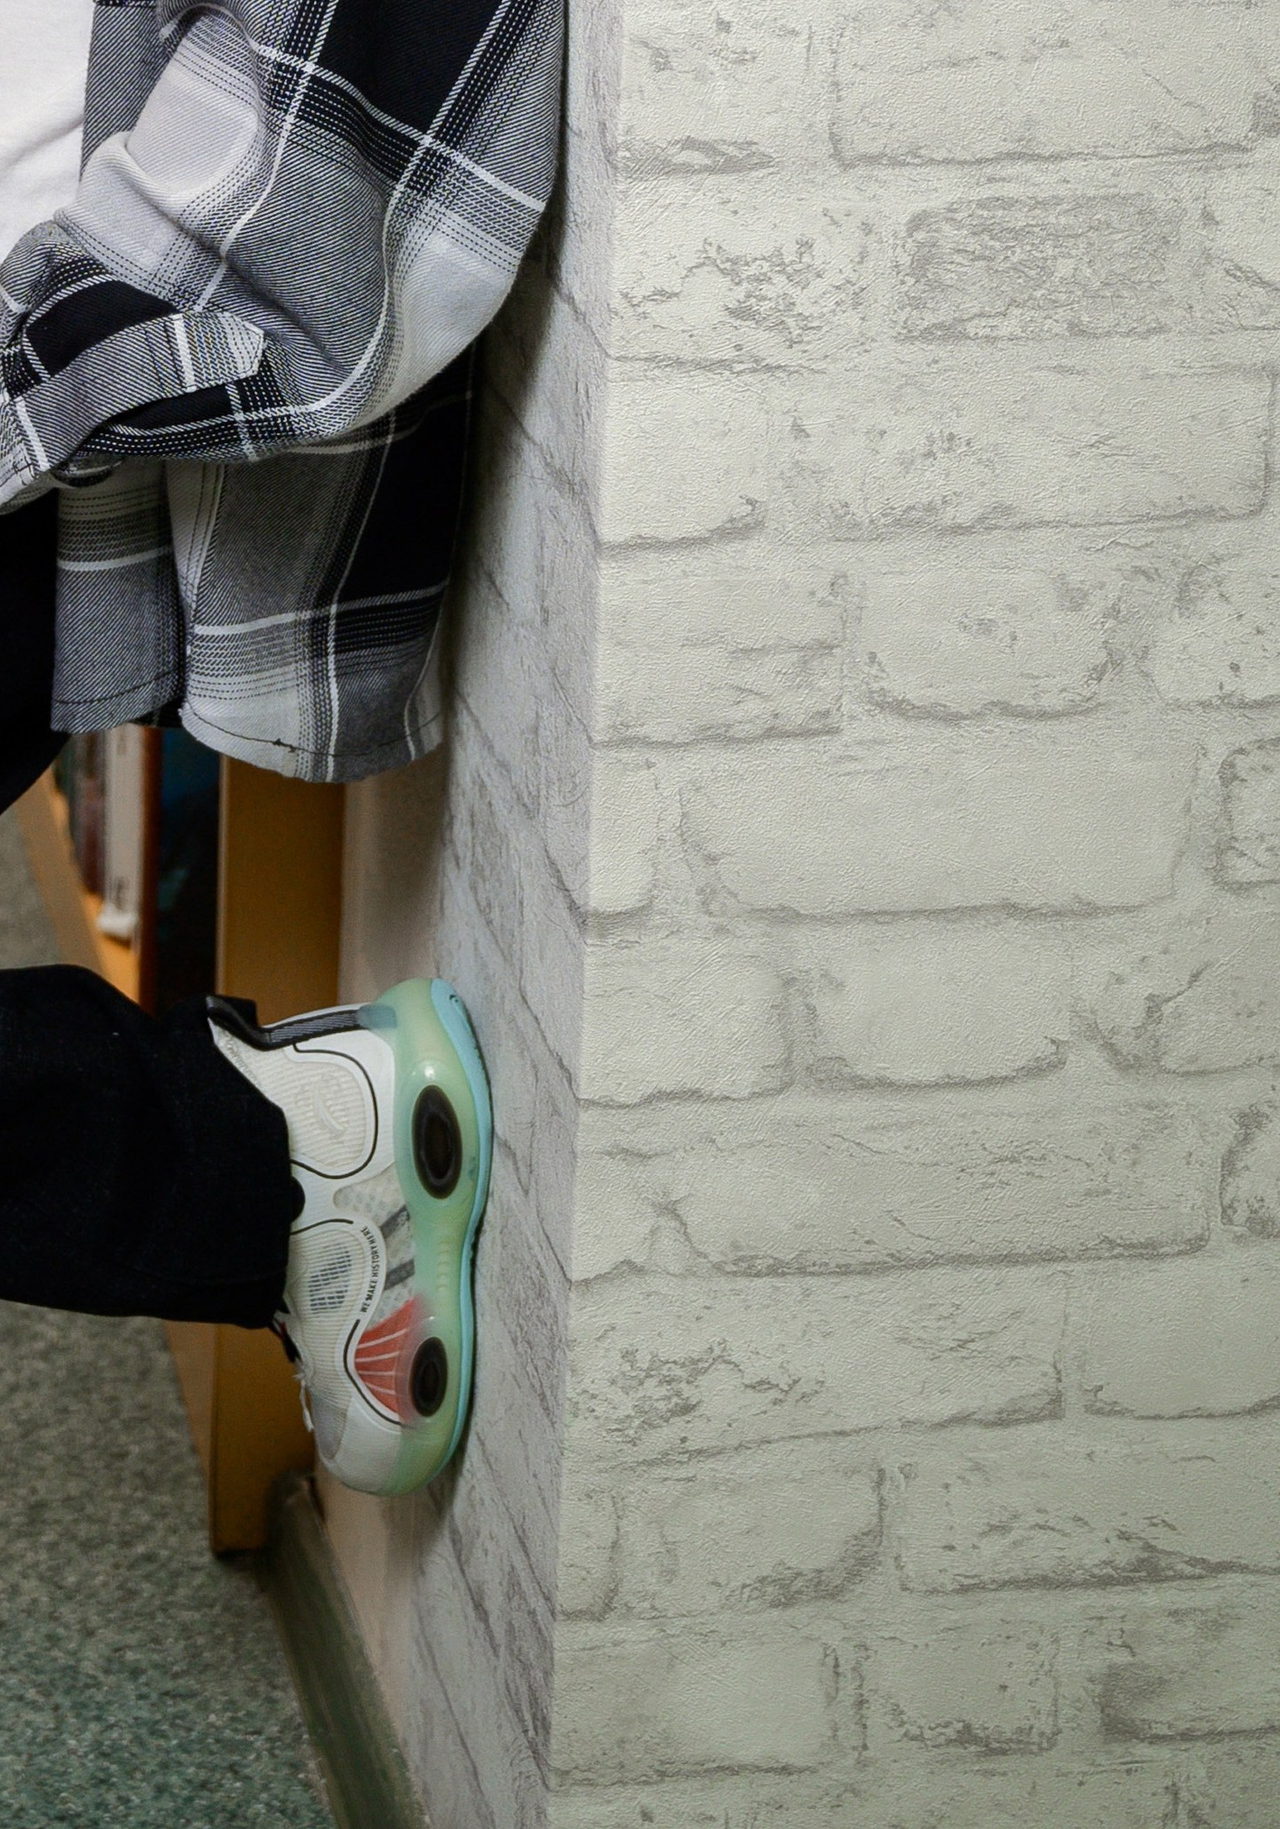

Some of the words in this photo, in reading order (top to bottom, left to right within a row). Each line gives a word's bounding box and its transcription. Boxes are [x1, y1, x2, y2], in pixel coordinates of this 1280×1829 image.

[361, 1226, 377, 1244] HERE
[370, 1245, 380, 1278] HISTORY
[365, 1280, 377, 1302] MAKE
[361, 1302, 370, 1313] WE
